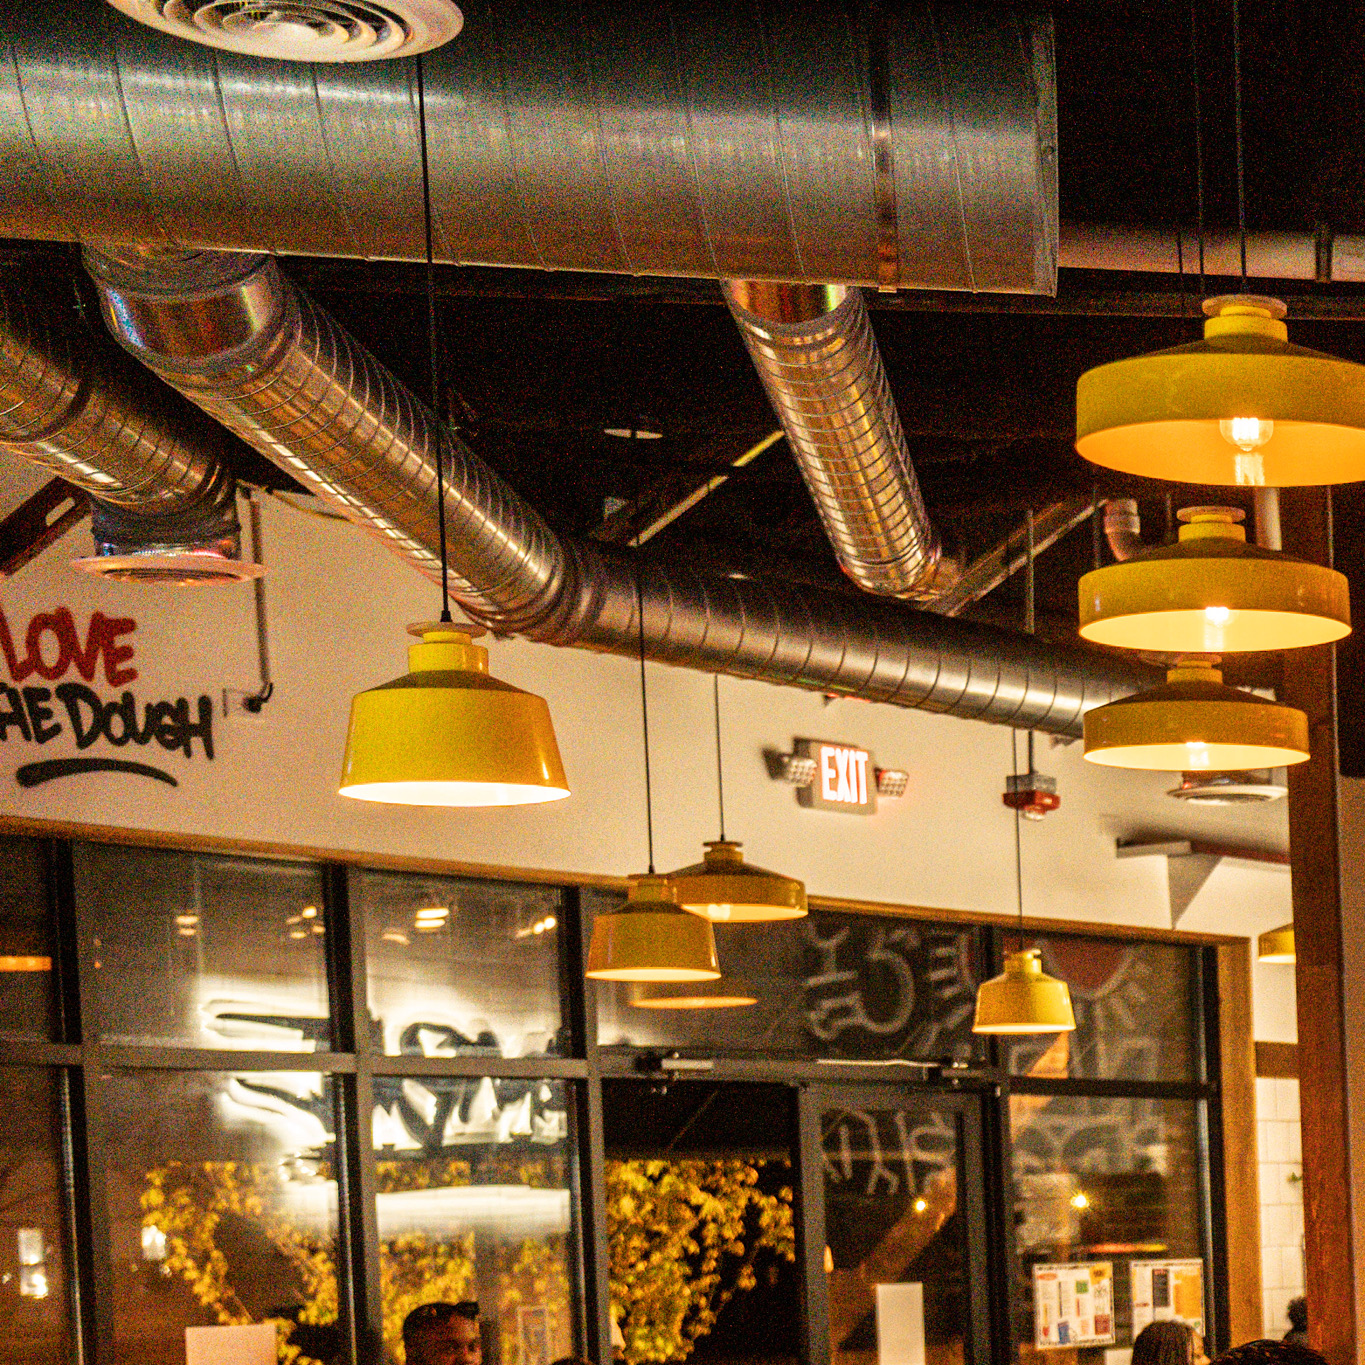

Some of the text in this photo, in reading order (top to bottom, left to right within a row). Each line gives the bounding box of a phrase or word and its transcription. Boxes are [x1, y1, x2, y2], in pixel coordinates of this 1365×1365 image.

[0, 606, 138, 687] LOVE
[55, 682, 214, 760] DOUGH
[820, 745, 868, 804] EXIT
